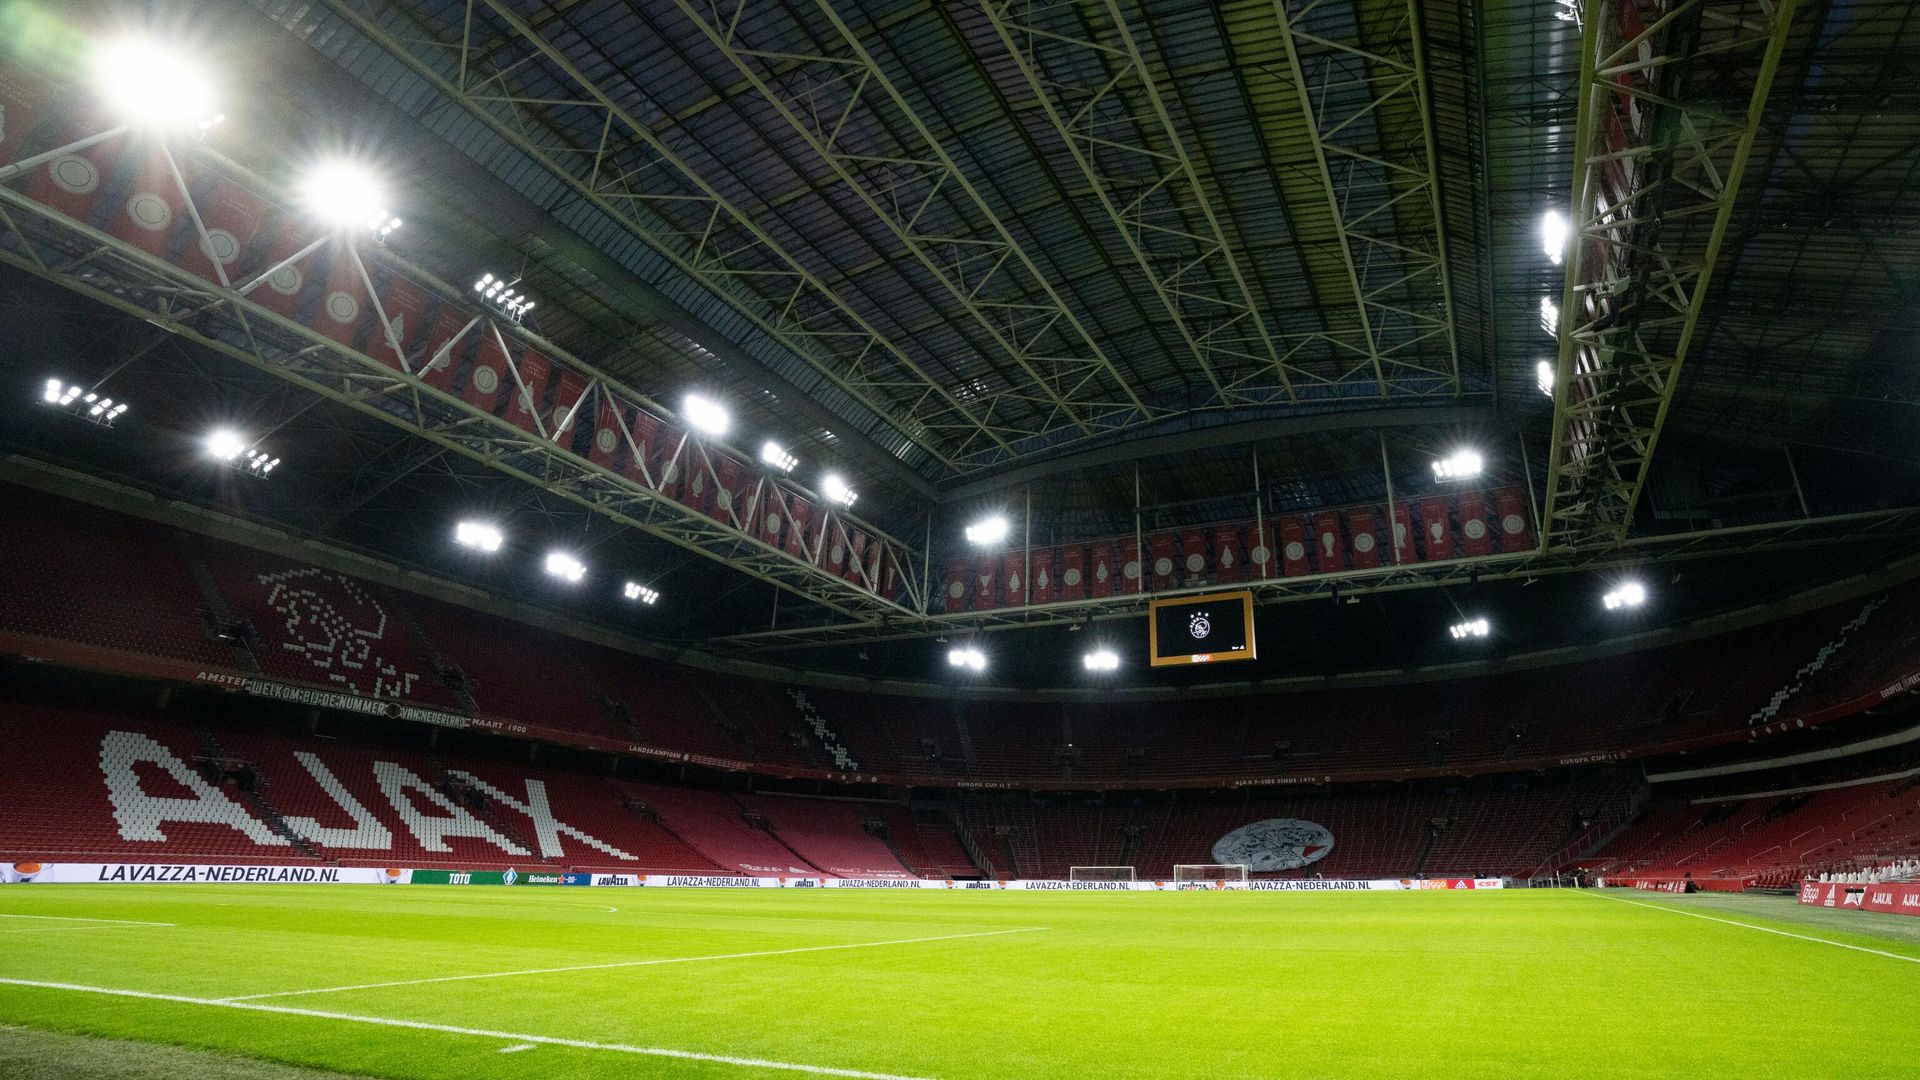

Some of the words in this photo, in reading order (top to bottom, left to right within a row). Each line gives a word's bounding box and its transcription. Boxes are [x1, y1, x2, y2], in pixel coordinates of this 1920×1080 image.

[251, 681, 302, 701] WELKOM
[303, 690, 321, 706] BIJ
[321, 693, 337, 708] DE
[338, 695, 386, 717] NUMMER
[401, 707, 419, 722] VAN
[420, 710, 466, 729] NEDERLAND
[472, 718, 504, 730] MAART
[508, 725, 527, 734] 1900
[1560, 757, 1590, 765] EUROPA
[1591, 754, 1608, 762] CUP
[99, 730, 638, 862] AJAX
[98, 865, 341, 882] LAVAZZA-NEDERLAND.NL
[448, 873, 471, 885] TOTO
[528, 875, 558, 883] Heineken
[598, 875, 628, 885] LAVAZZA
[667, 877, 760, 887] LAVAZZA-NEDERLAND.NL
[795, 878, 814, 887] LAVAZZA
[838, 879, 921, 888] LAVAZZA-NEDERLAND.NL
[966, 881, 991, 889] LAVAZZA
[1025, 881, 1130, 890] LAVAZZA-NEDERLAND.NL
[1249, 881, 1372, 891] LAVAZZA-NEDERLAND.NL
[1871, 892, 1893, 905] AJAX.NL
